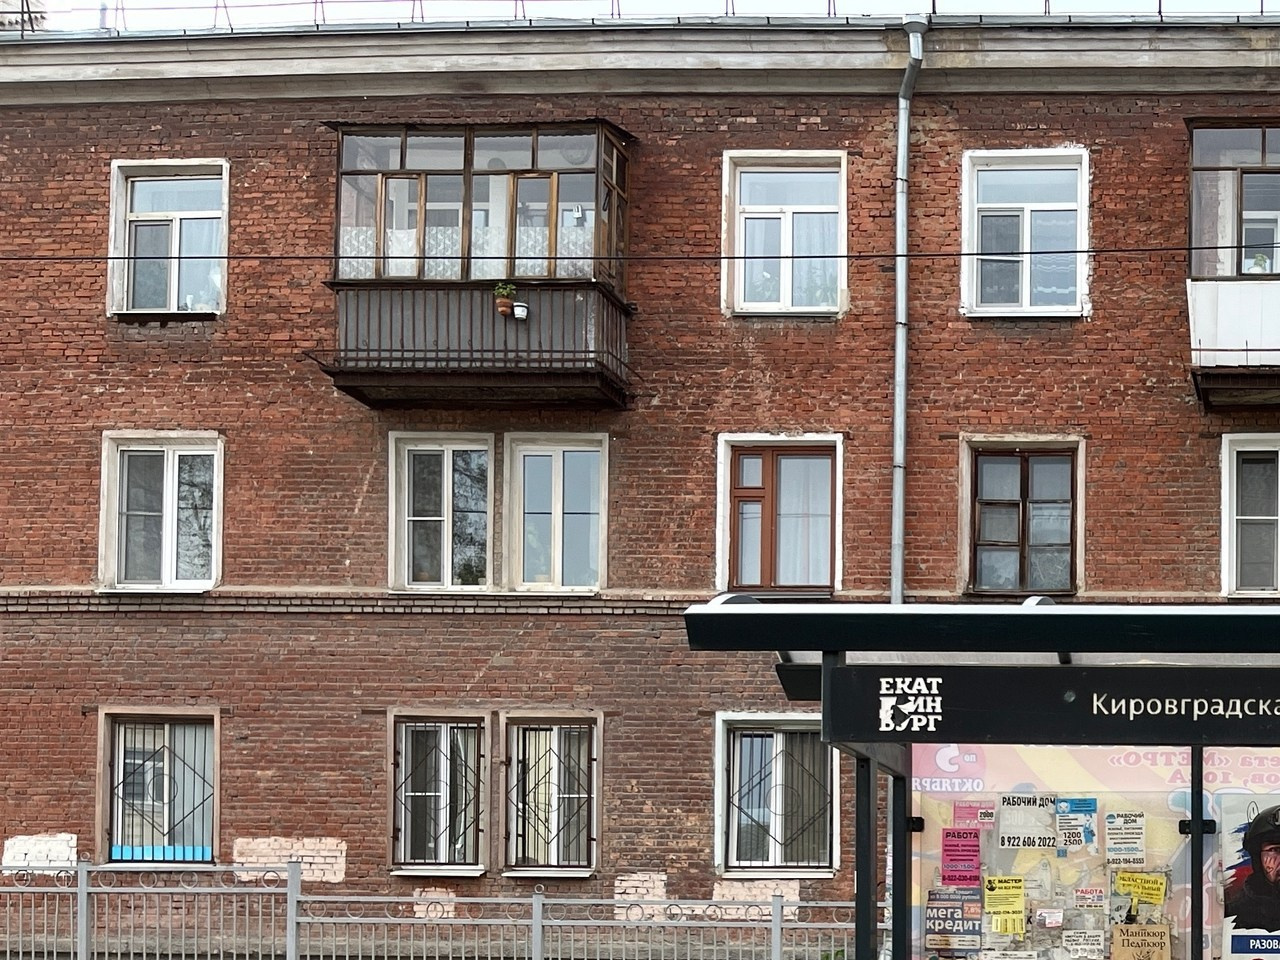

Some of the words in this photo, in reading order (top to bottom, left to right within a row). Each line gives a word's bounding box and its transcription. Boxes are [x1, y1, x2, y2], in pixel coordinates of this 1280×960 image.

[879, 677, 943, 694] ЕКАТ
[1002, 796, 1037, 806] РАБОЧИЙ
[1038, 797, 1056, 808] ДОМ
[945, 831, 979, 839] РАБОТА
[1000, 836, 1006, 847] 8
[1007, 836, 1021, 847] 922
[1022, 836, 1036, 847] 606
[1038, 836, 1057, 848] 2022
[926, 908, 962, 918] мега
[926, 919, 981, 933] кредит
[1119, 928, 1166, 940] Маникюр
[1121, 939, 1166, 950] Педикюр
